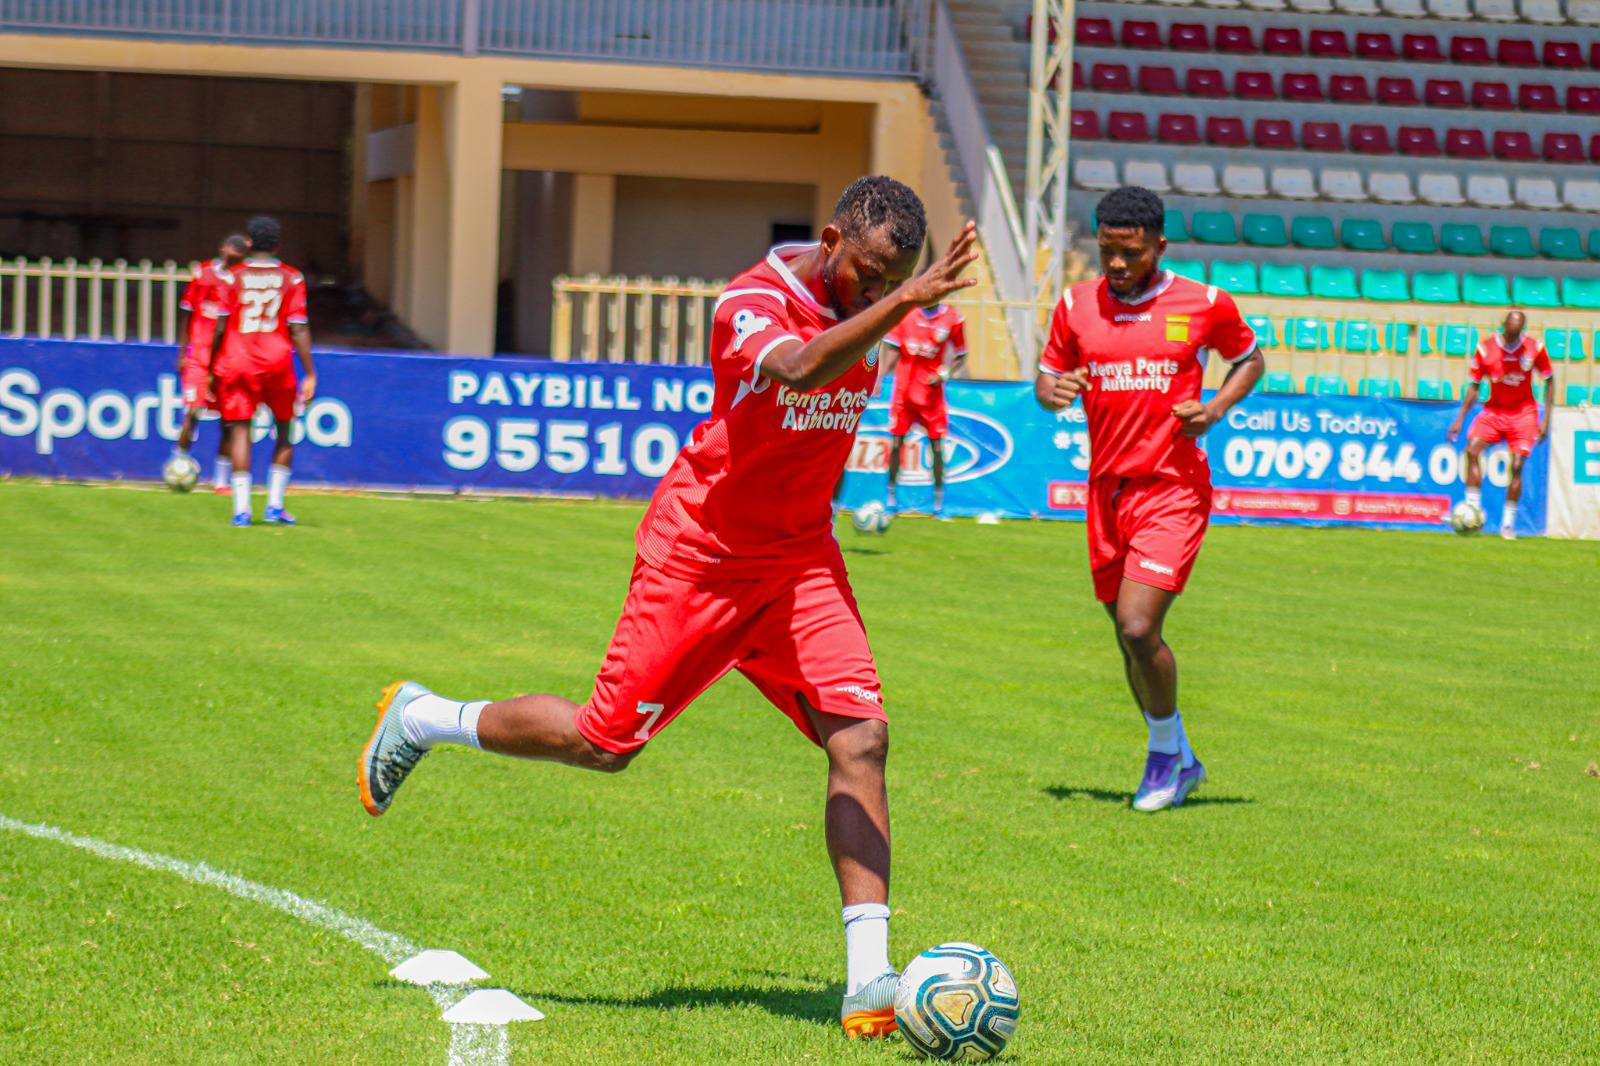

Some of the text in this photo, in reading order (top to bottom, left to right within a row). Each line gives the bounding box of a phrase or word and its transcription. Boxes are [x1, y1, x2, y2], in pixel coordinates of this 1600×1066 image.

[1088, 357, 1178, 379] Kenya Ports
[450, 373, 714, 413] PAYBILL NO
[776, 385, 831, 415] Kenya
[1101, 375, 1170, 394] Authority
[781, 406, 861, 434] Authority
[1228, 408, 1398, 440] Call Us Today:
[443, 416, 694, 477] 95510
[1224, 437, 1332, 479] 0709
[1338, 442, 1421, 483] 844
[634, 701, 664, 740] 7
